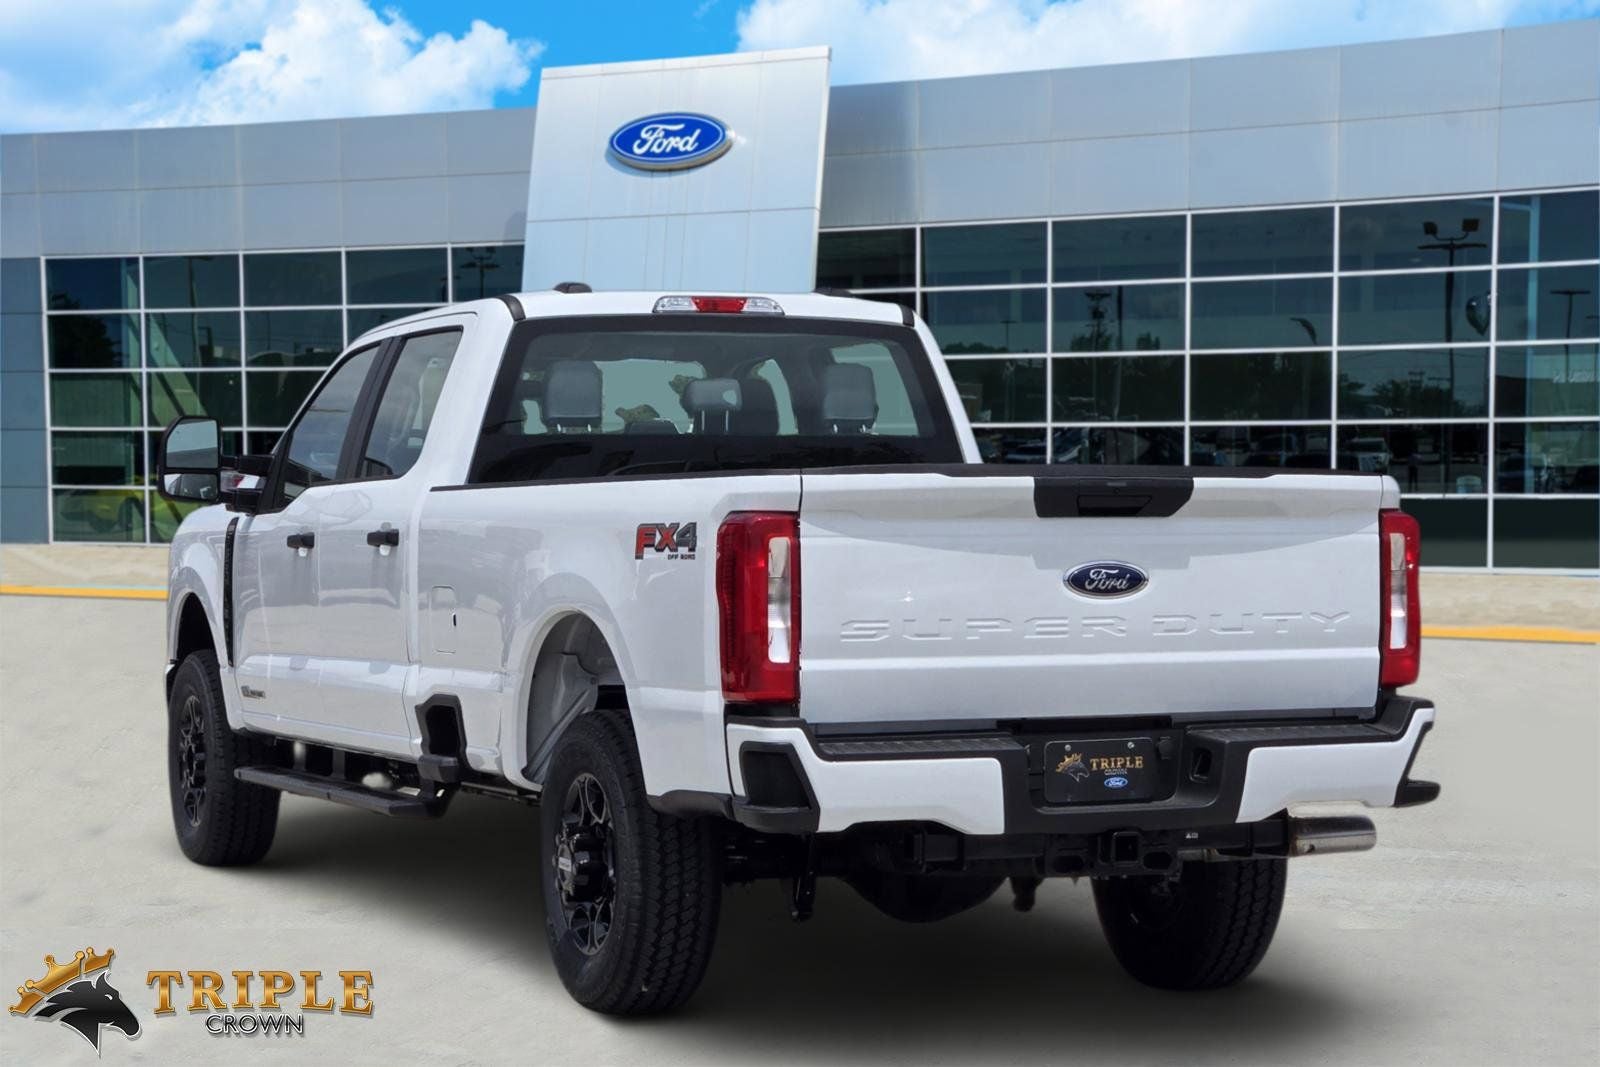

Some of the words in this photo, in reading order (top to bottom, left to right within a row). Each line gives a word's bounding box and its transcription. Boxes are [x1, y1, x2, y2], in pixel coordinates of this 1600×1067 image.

[632, 123, 702, 155] Ford
[635, 522, 697, 560] FX4
[1084, 568, 1130, 590] Ford
[840, 617, 1129, 642] SUPER
[1152, 611, 1351, 635] DUTY
[1090, 756, 1144, 771] TRIPLE
